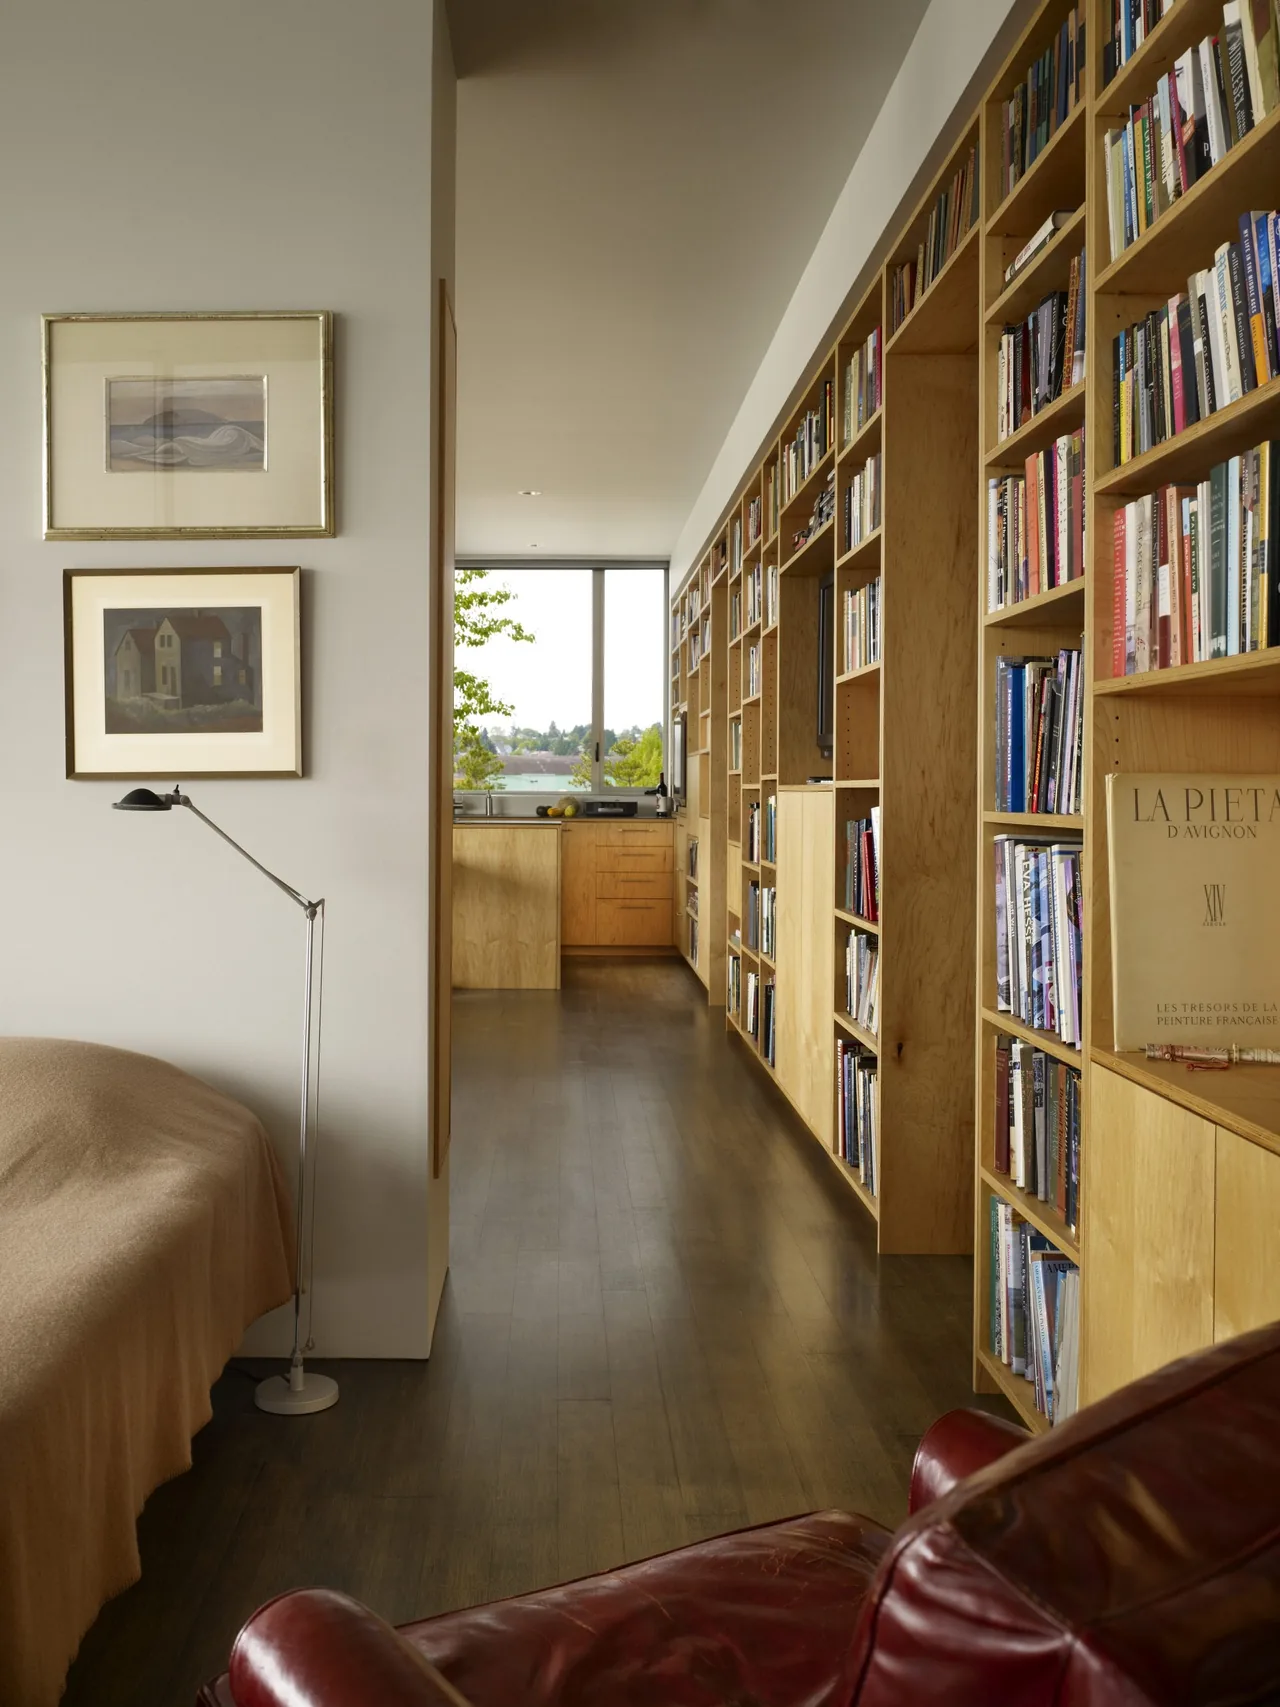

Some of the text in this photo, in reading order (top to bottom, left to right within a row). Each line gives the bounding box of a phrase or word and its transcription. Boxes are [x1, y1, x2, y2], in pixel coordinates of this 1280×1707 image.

[1228, 42, 1244, 109] MIDDLESEX
[1243, 229, 1248, 237] MY
[1231, 252, 1239, 282] william
[1236, 312, 1247, 360] fascination
[1204, 361, 1212, 405] CONSENT
[1133, 788, 1171, 822] LA
[1167, 825, 1257, 839] D'AVIGNON
[1022, 860, 1030, 890] EVA
[1203, 884, 1226, 921] XIV
[1023, 897, 1032, 944] HESSE
[1156, 1003, 1177, 1013] LES
[1242, 1003, 1258, 1012] DE
[1263, 1003, 1278, 1012] LA
[1157, 1016, 1277, 1026] PEINTURE FRANÇAISE
